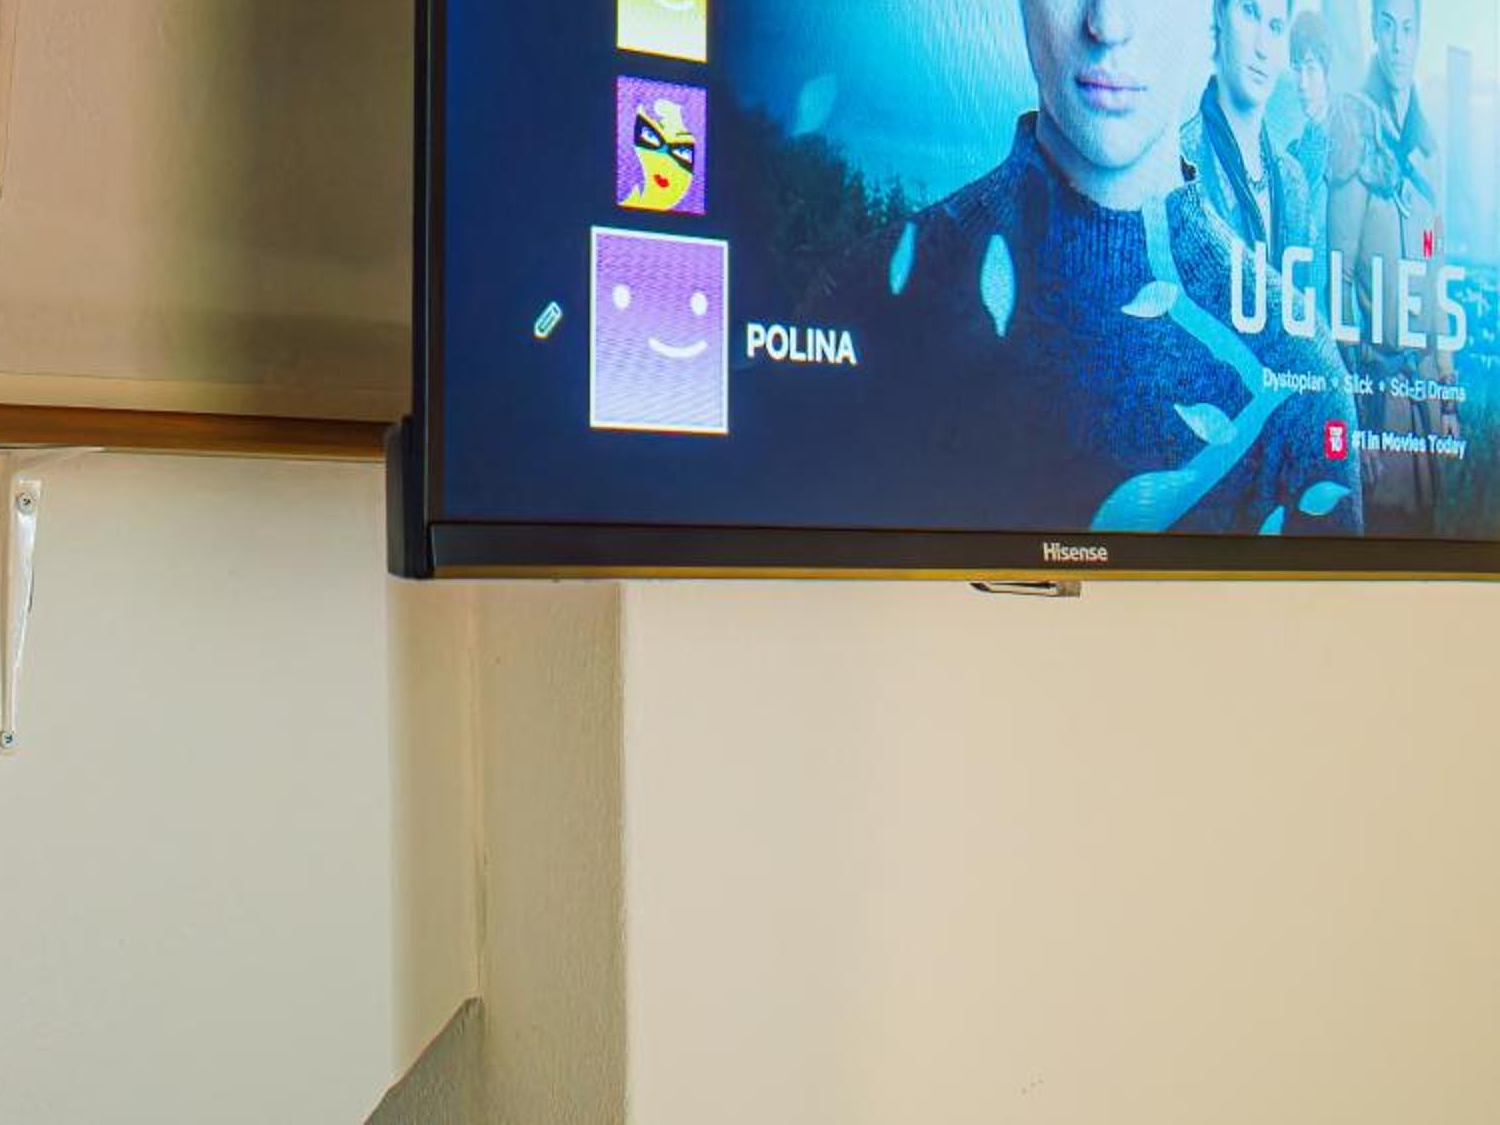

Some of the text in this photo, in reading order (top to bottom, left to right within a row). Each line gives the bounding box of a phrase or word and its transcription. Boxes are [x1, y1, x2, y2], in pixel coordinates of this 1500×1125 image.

[1230, 239, 1468, 353] UGLIES
[746, 322, 858, 366] POLINA
[1262, 367, 1327, 396] Dystopian
[1428, 381, 1467, 402] Drama
[1367, 430, 1380, 450] in
[1381, 432, 1427, 452] Movies
[1427, 434, 1467, 460] Today
[1043, 541, 1109, 562] Hisense
